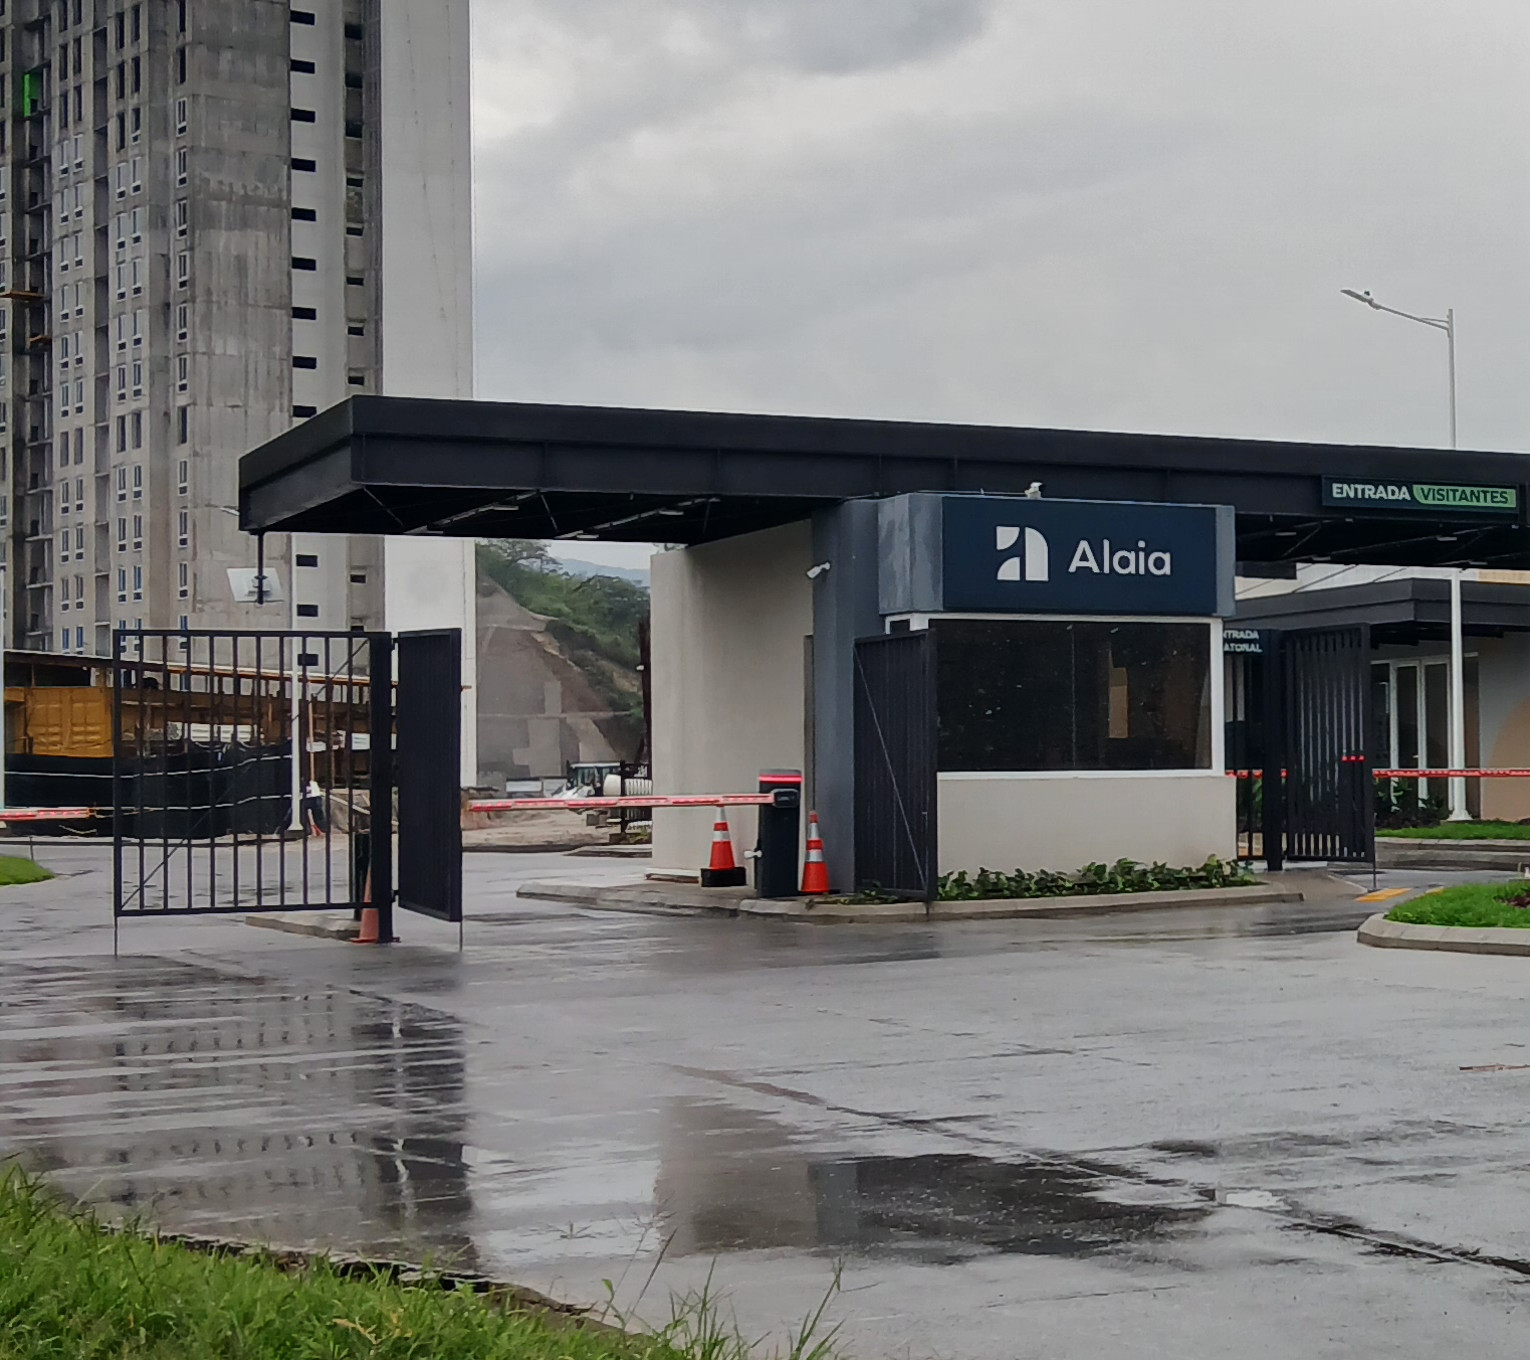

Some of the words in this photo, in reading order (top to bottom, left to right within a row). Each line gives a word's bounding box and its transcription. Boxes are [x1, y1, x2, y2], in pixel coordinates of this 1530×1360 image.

[1332, 483, 1411, 501] ENTRADA
[1420, 487, 1508, 504] VISITANTES
[1068, 539, 1171, 576] Alaia
[1223, 629, 1259, 640] NTRADA
[1223, 642, 1262, 652] ATONAL
